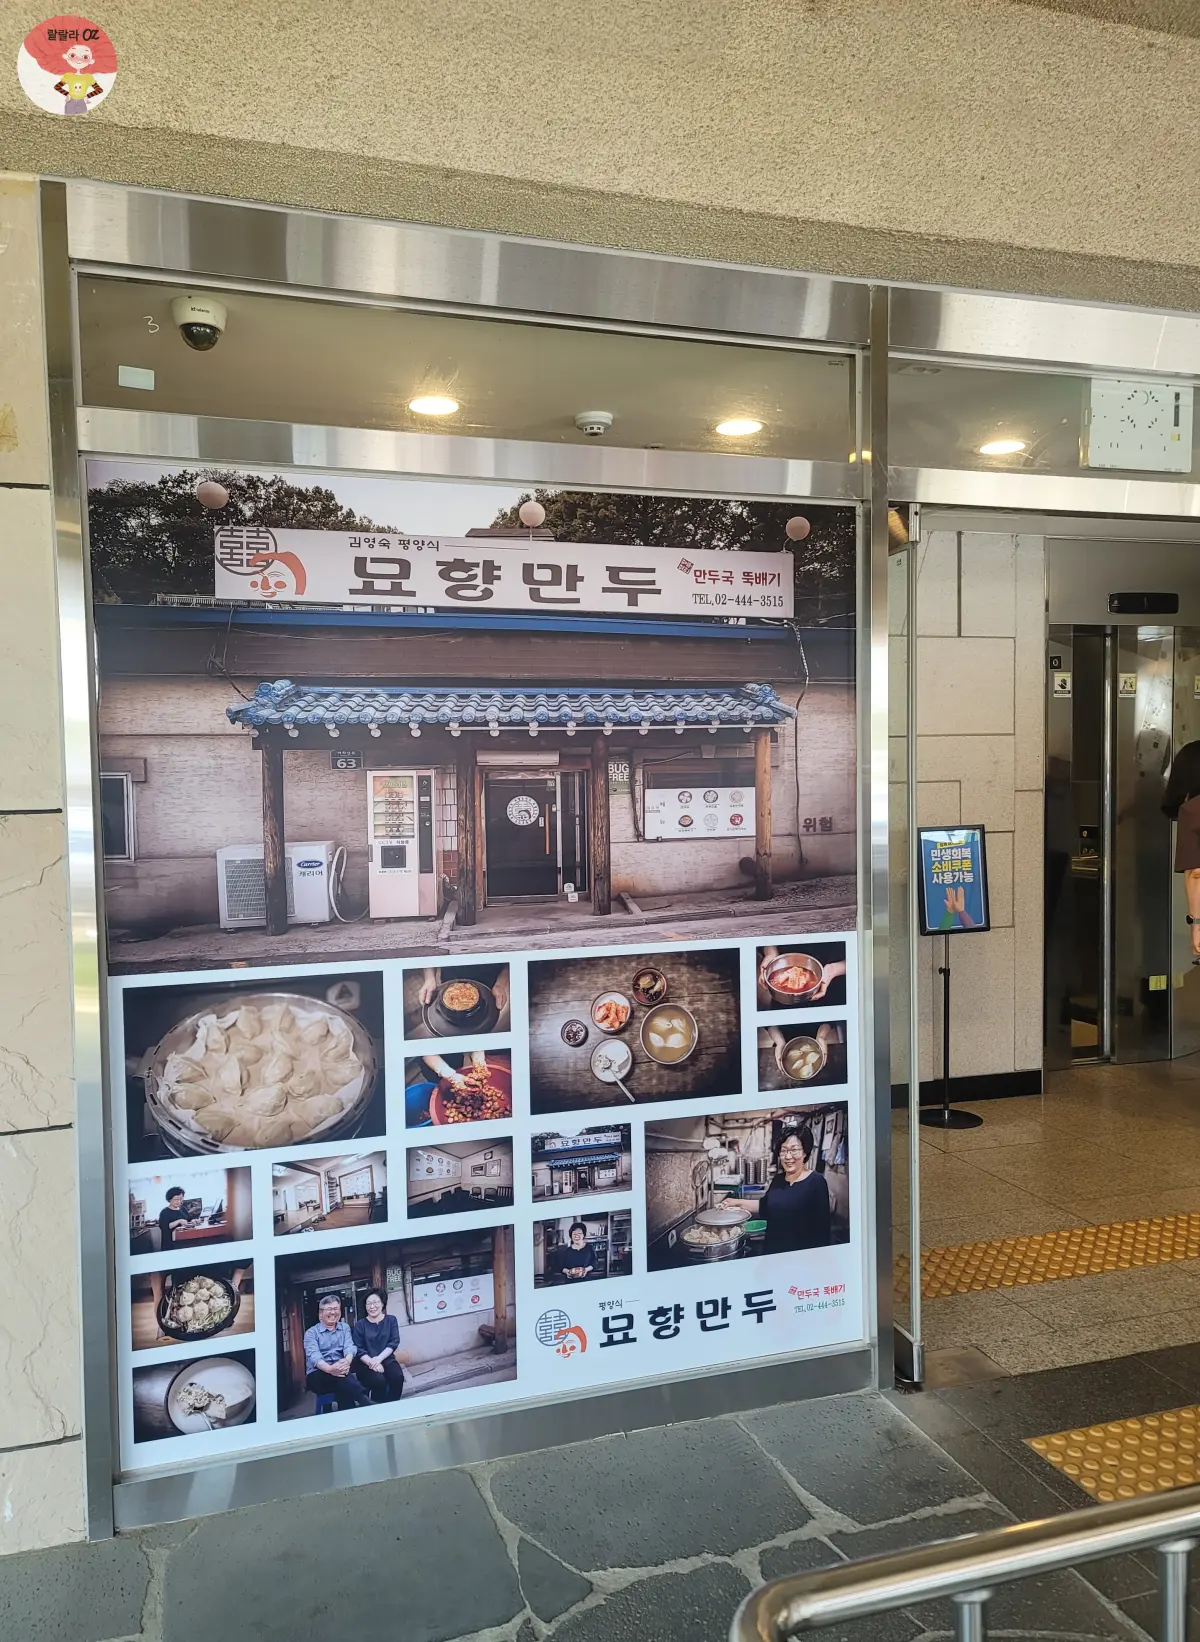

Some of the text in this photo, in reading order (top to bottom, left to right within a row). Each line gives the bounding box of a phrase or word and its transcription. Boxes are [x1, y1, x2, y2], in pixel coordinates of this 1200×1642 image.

[142, 315, 160, 333] 3
[348, 536, 440, 551] 김영숙 평양식
[349, 556, 662, 607] 묘향만두
[693, 569, 781, 588] 만두국 뚝배기
[336, 758, 357, 769] 63
[608, 763, 630, 773] BUG
[608, 773, 630, 782] FREE
[802, 816, 834, 833] 위험
[931, 847, 972, 861] 민생회복
[931, 859, 973, 873] 소비쿠폰
[932, 871, 975, 884] 사용가능
[386, 1268, 402, 1277] BUG
[797, 1287, 819, 1300] 만두국
[823, 1283, 846, 1296] 뚝배기
[598, 1298, 623, 1311] 평양식
[599, 1289, 777, 1348] 묘향만두
